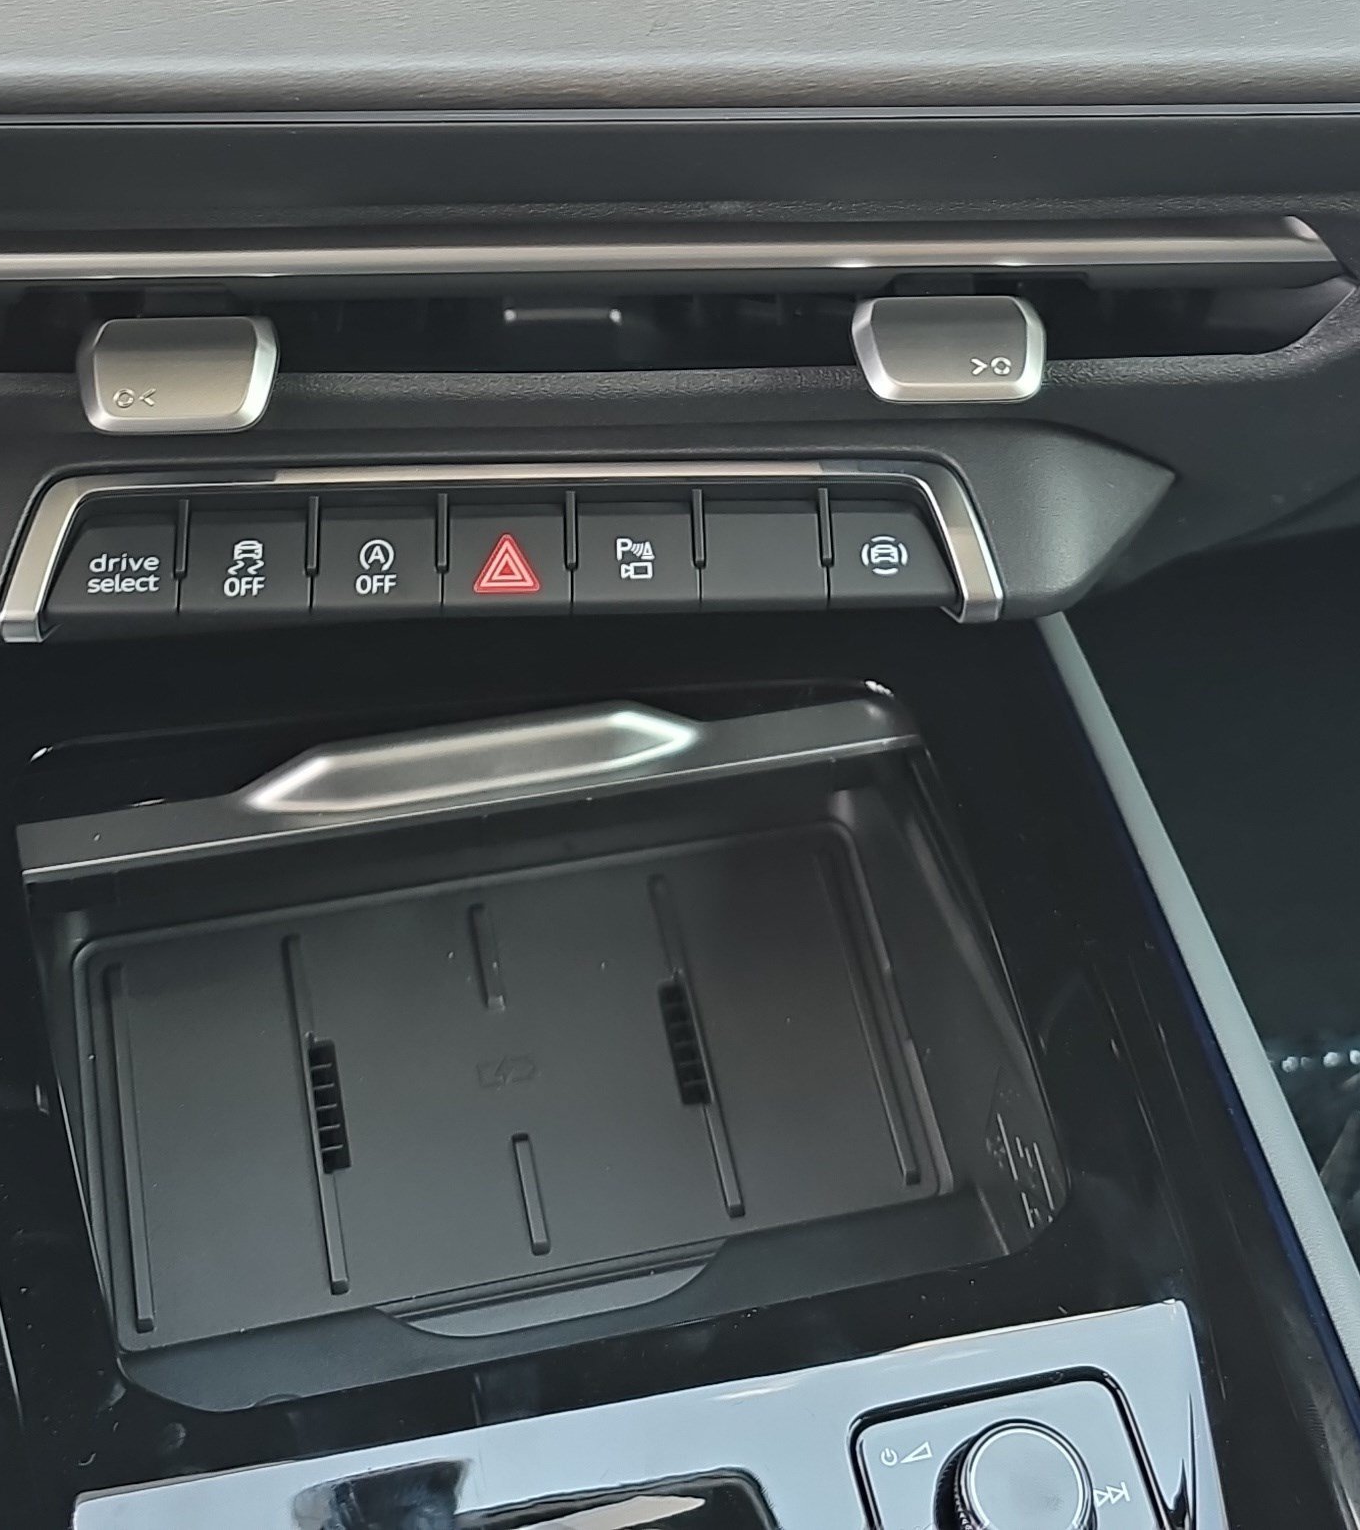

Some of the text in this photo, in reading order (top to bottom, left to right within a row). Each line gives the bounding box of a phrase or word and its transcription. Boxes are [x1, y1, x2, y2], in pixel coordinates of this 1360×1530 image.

[89, 552, 160, 573] drive
[87, 573, 160, 594] select
[223, 576, 265, 597] OFF
[355, 574, 397, 595] OFF
